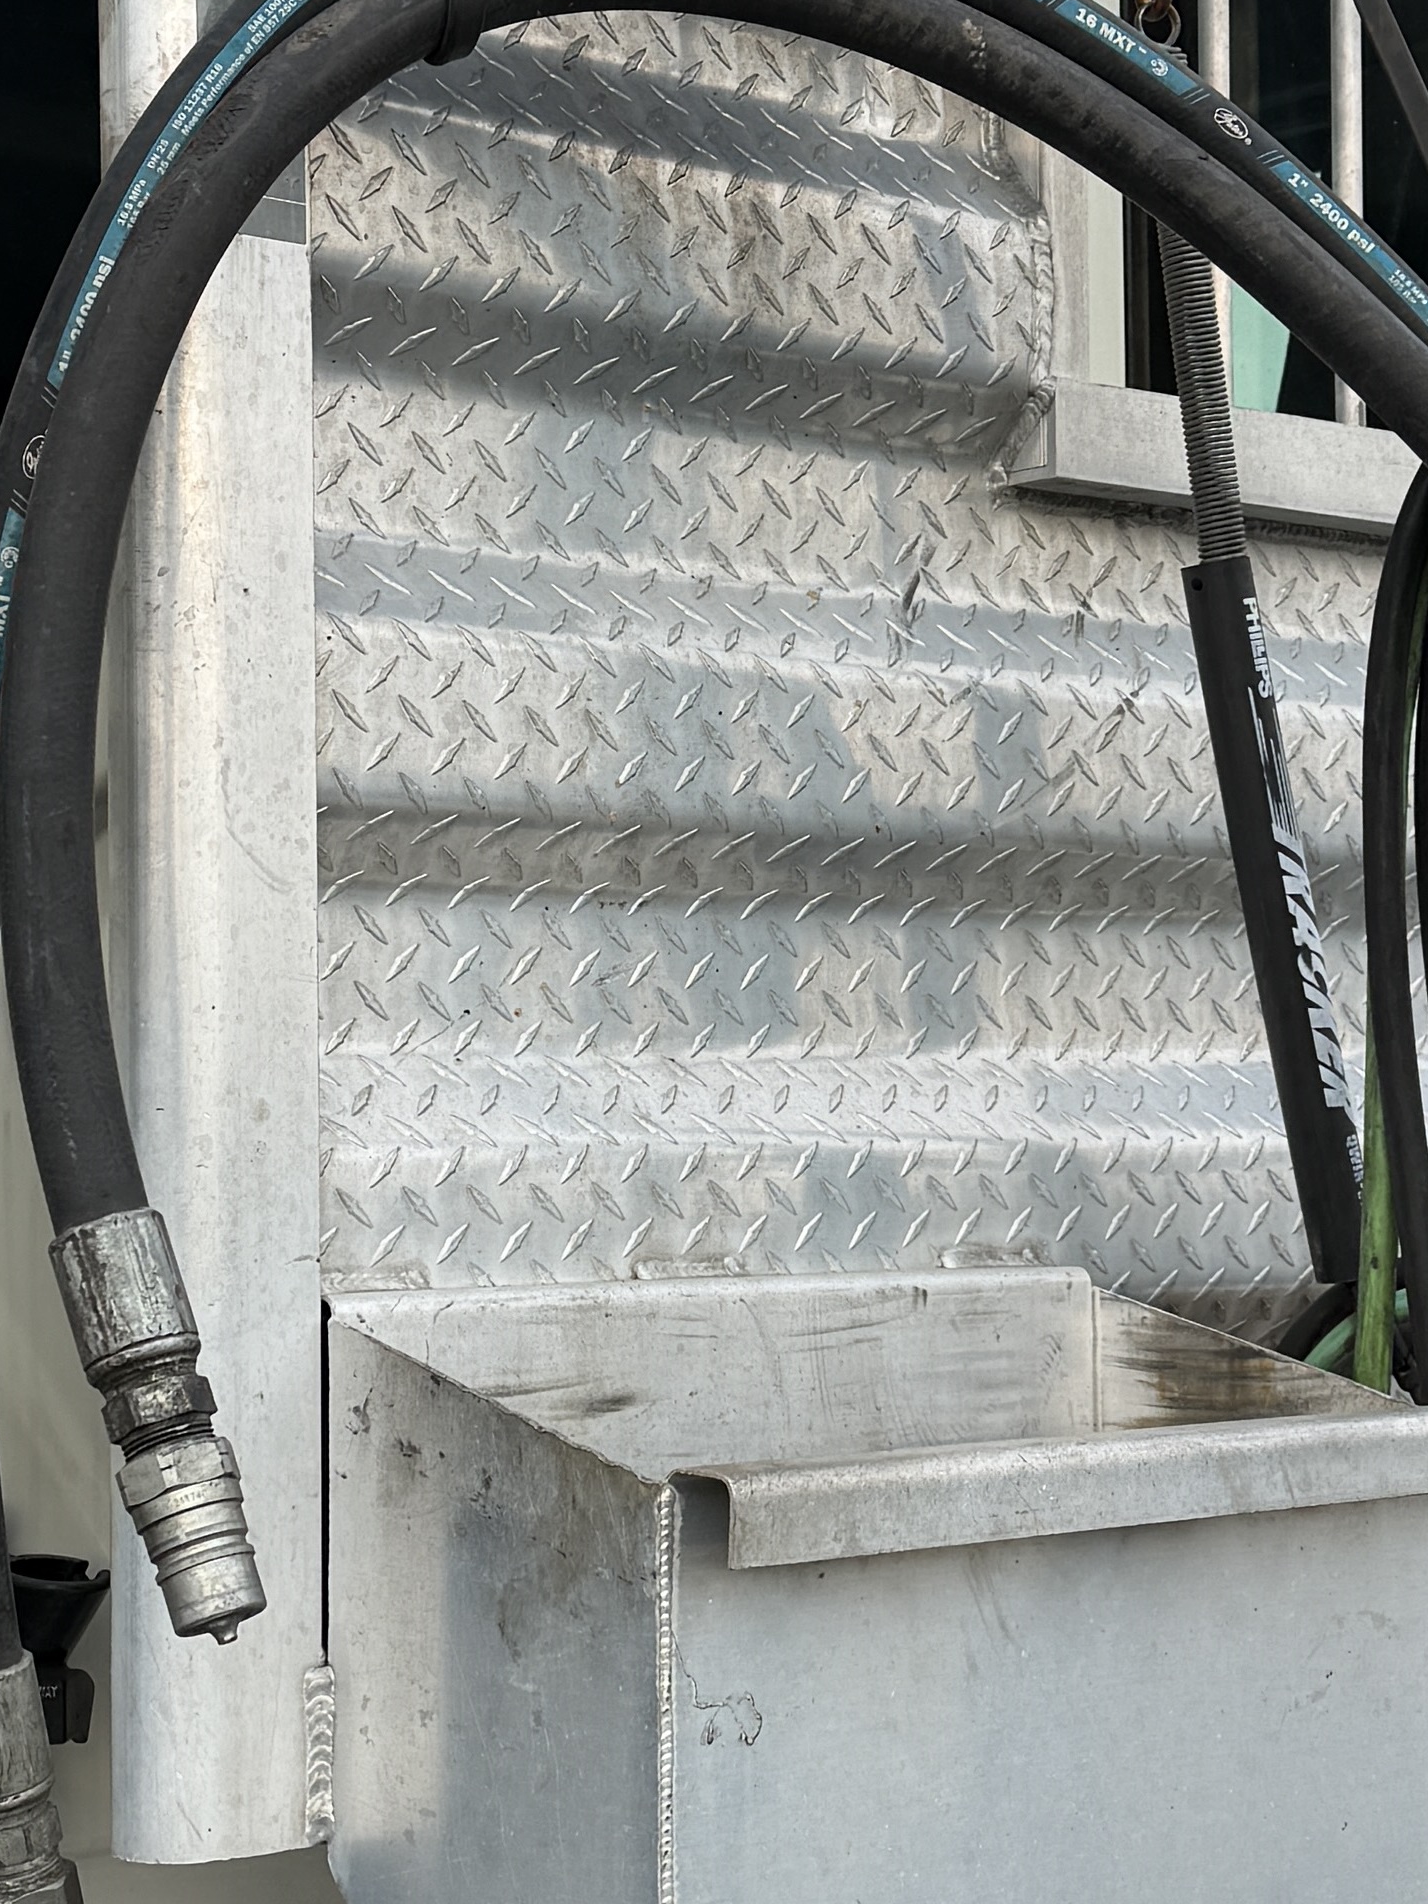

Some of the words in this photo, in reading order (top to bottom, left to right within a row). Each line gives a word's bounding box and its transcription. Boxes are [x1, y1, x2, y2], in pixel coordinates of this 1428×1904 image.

[1075, 8, 1097, 28] 16
[251, 31, 266, 47] EN
[1309, 193, 1349, 231] 2400
